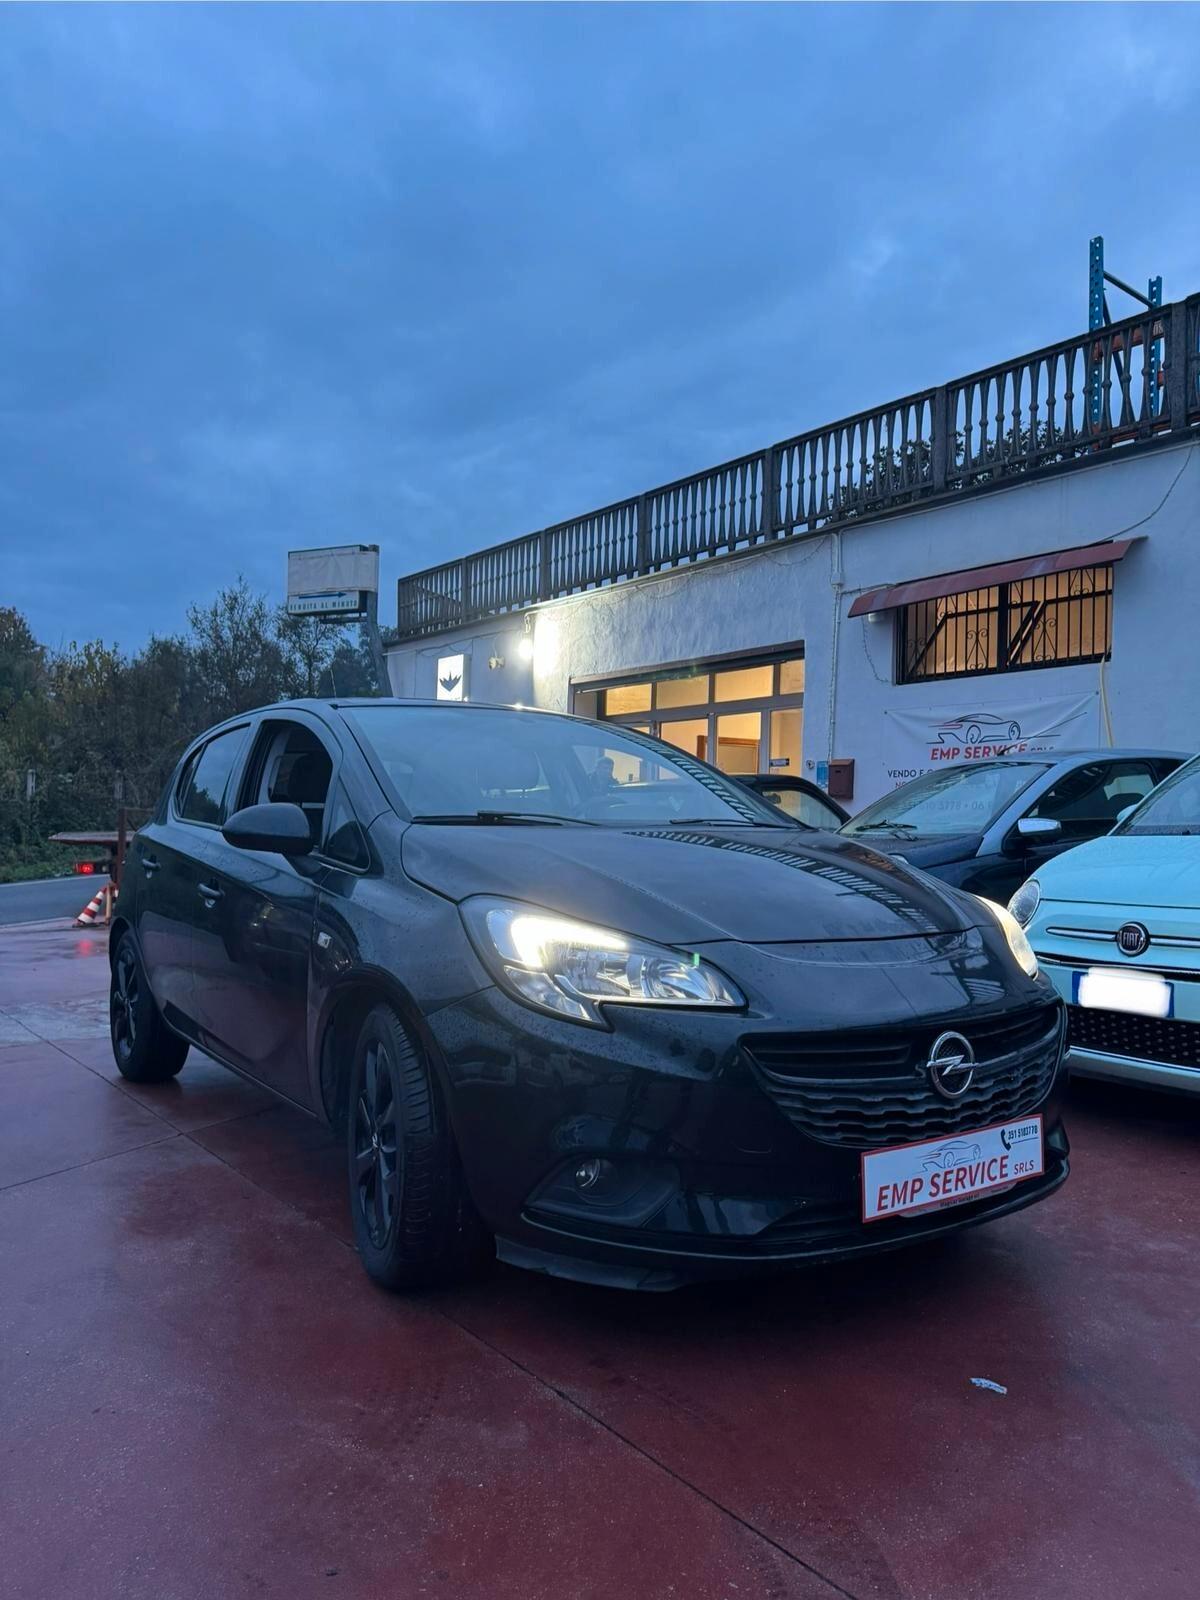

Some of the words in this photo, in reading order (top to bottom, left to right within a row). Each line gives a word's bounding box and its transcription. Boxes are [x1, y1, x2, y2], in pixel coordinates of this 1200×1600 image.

[931, 747, 960, 760] EMP
[888, 769, 917, 778] VENDO
[1123, 932, 1139, 946] FIAT
[877, 1177, 924, 1212] EMP
[928, 1155, 1010, 1198] SERVICE
[1014, 1160, 1034, 1175] SRLS
